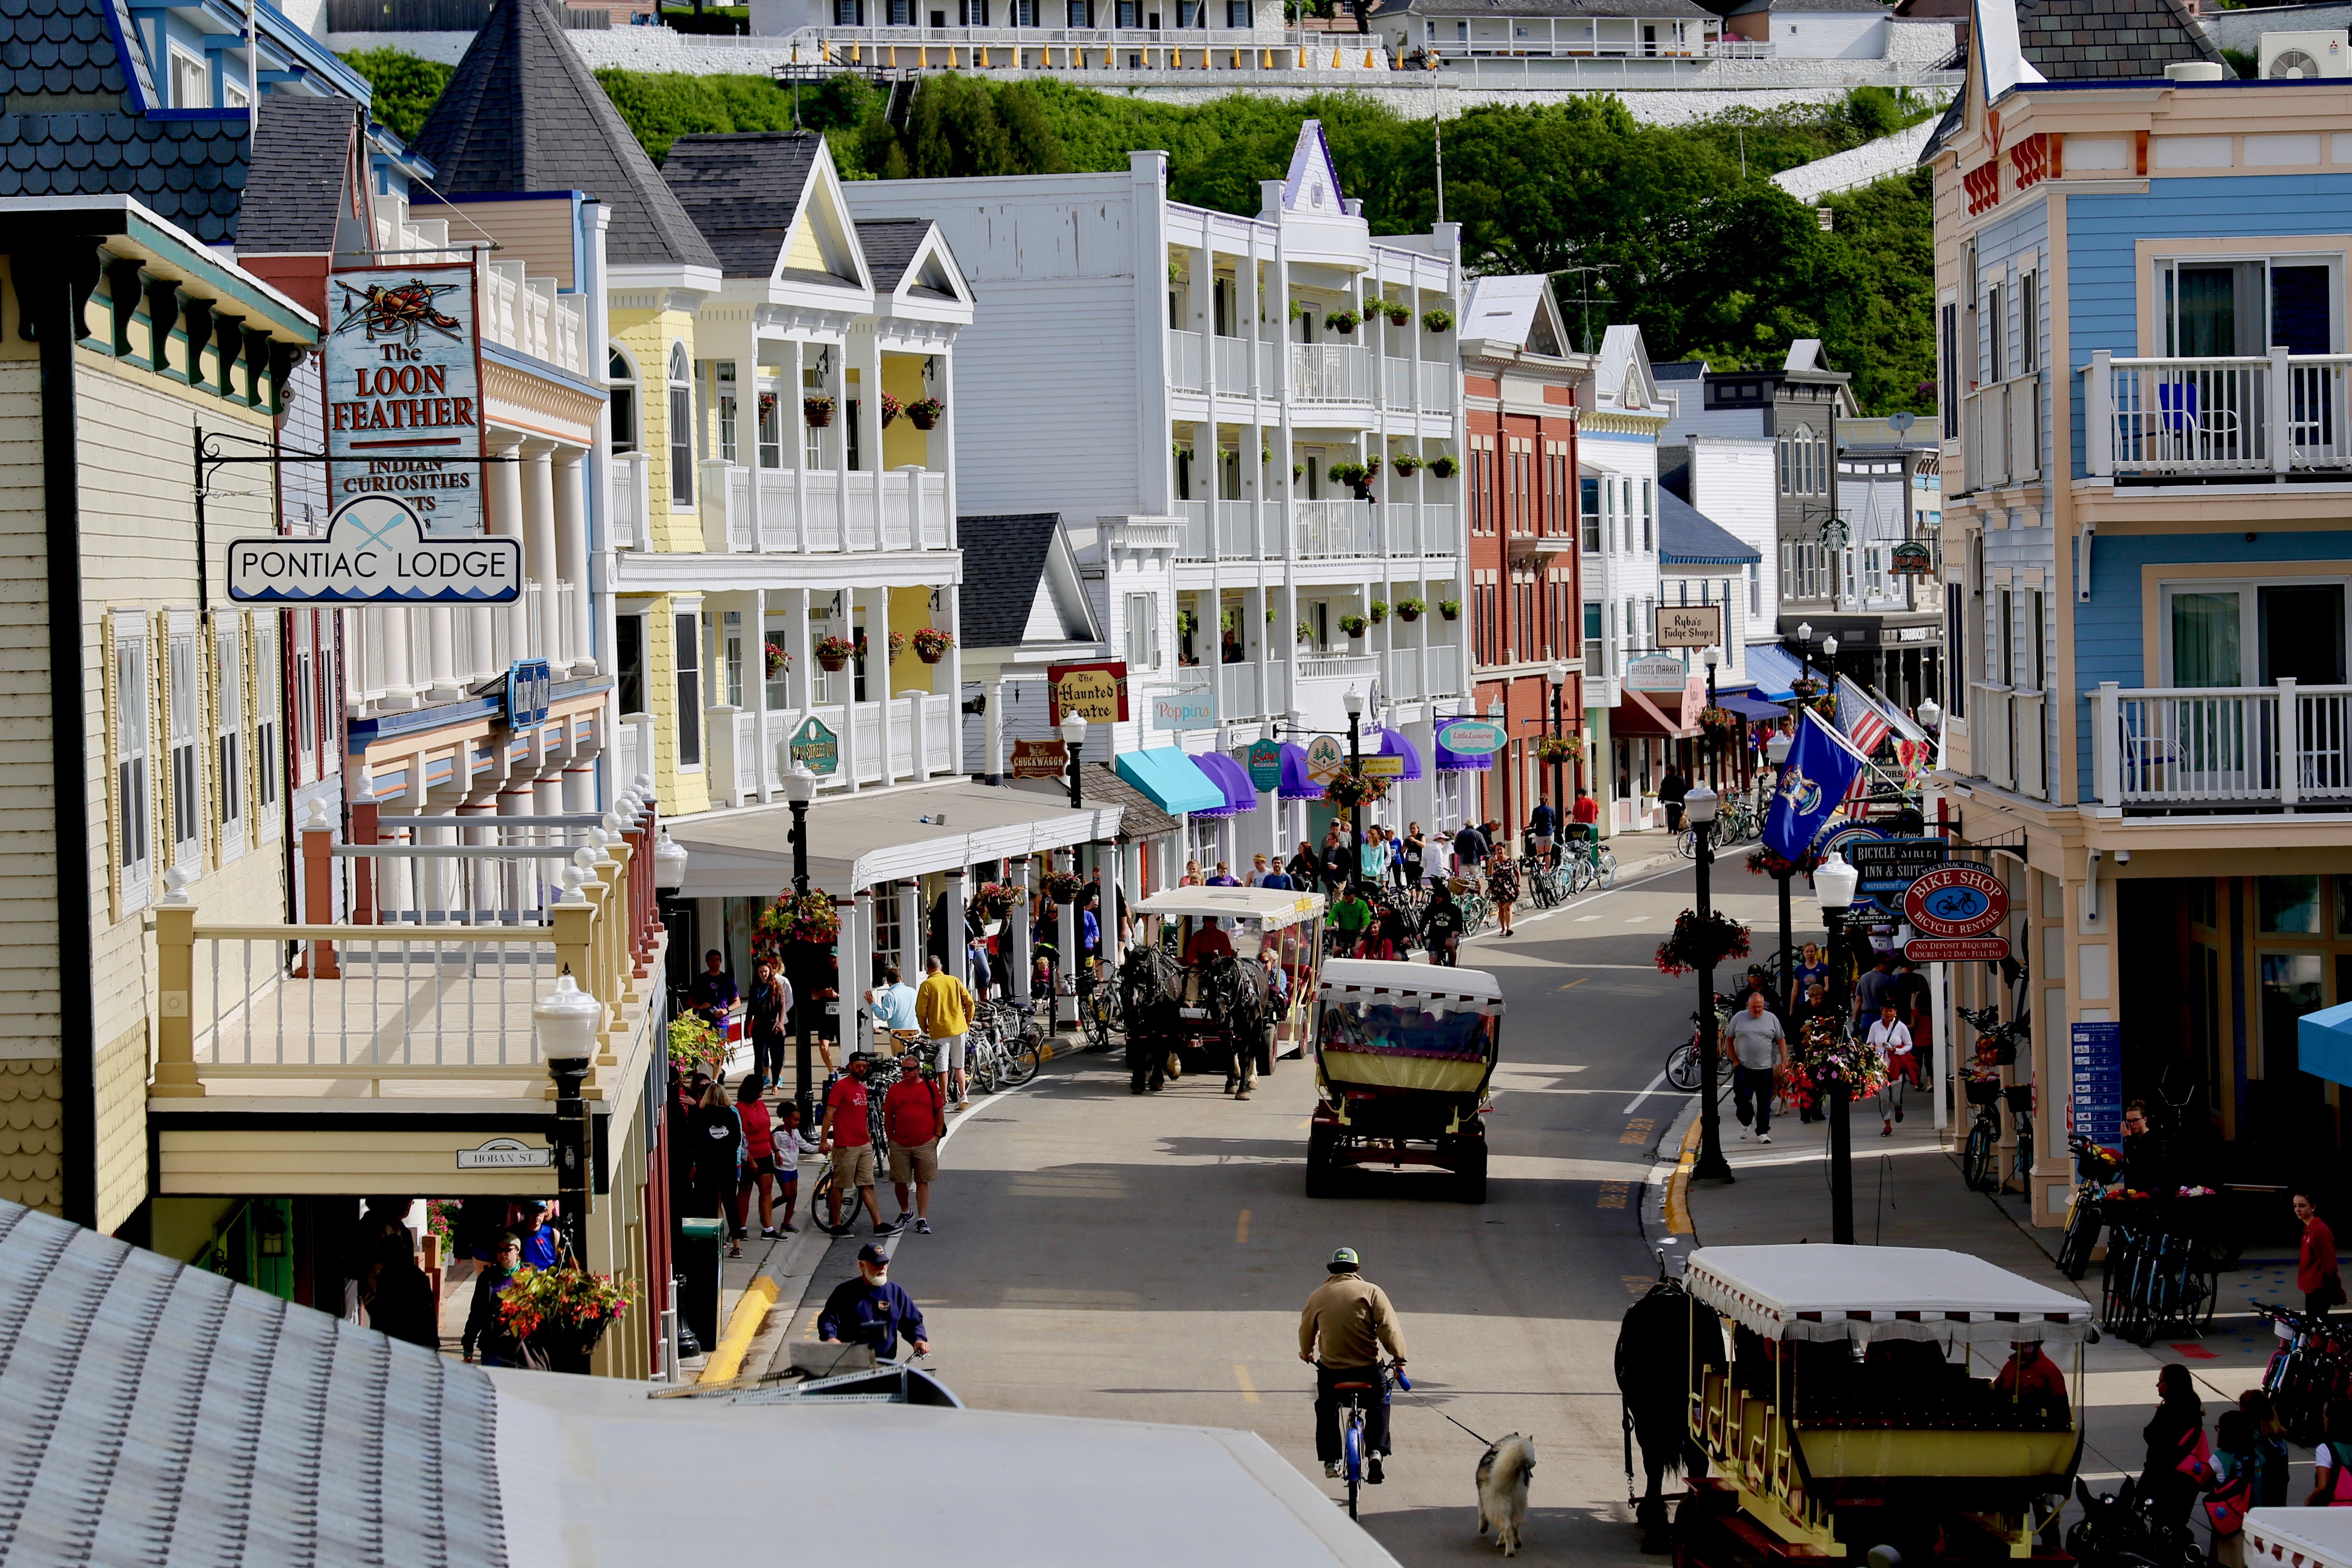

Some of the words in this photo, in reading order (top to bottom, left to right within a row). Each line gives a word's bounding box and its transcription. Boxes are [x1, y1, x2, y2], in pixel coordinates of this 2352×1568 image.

[379, 343, 422, 361] The
[355, 365, 446, 396] LOON
[331, 397, 475, 430] FEATHER
[368, 461, 442, 473] INDIAN
[343, 472, 469, 493] CURIOSITIES
[243, 552, 377, 577] PONTIAC
[398, 552, 505, 577] LODGE
[1893, 555, 1907, 566] PUB
[1911, 555, 1929, 566] GRILL
[1675, 614, 1702, 629] Ryba's
[1662, 627, 1686, 639] Fudge
[1689, 628, 1714, 639] Shops
[1900, 627, 1926, 641] STARBUCKS
[1632, 665, 1654, 675] ARTISTS
[1656, 665, 1680, 674] MARKET
[1078, 673, 1093, 682] The
[1059, 683, 1113, 701] Haunted
[1156, 702, 1209, 722] Poppins
[807, 743, 824, 760] STREET
[1014, 756, 1063, 766] CHUCKWAGON
[1858, 847, 1896, 861] BICYCLE
[1865, 866, 1882, 877] INN
[1886, 866, 1893, 876] &
[1922, 862, 1961, 875] MACKINAC
[1964, 862, 1990, 874] ISLAND
[1912, 872, 1952, 899] BIKE
[1960, 871, 2002, 896] SHOP
[1914, 911, 1954, 933] BICYCLE
[1960, 909, 2000, 933] RENTALS
[474, 1154, 514, 1163] HOBAN
[520, 1153, 536, 1162] ST.
